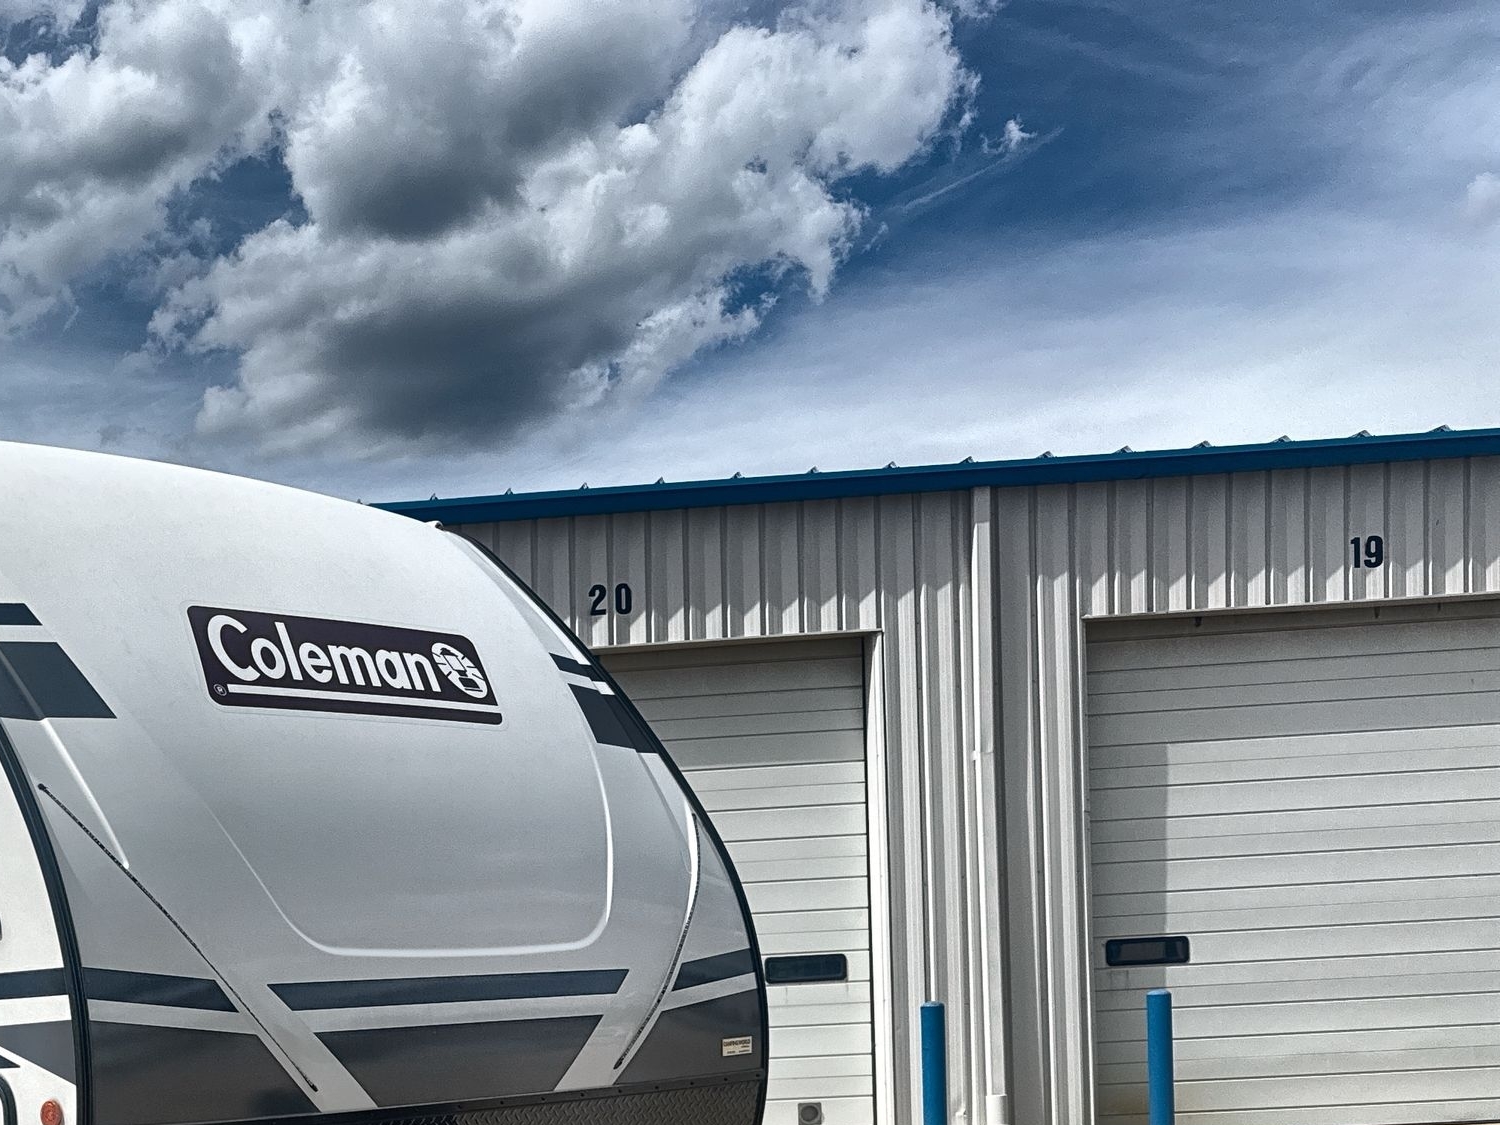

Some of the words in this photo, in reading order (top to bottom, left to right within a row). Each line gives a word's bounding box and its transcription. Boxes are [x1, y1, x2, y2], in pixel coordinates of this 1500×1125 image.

[1350, 535, 1384, 569] 19
[588, 583, 632, 616] 20
[207, 614, 442, 693] Coleman
